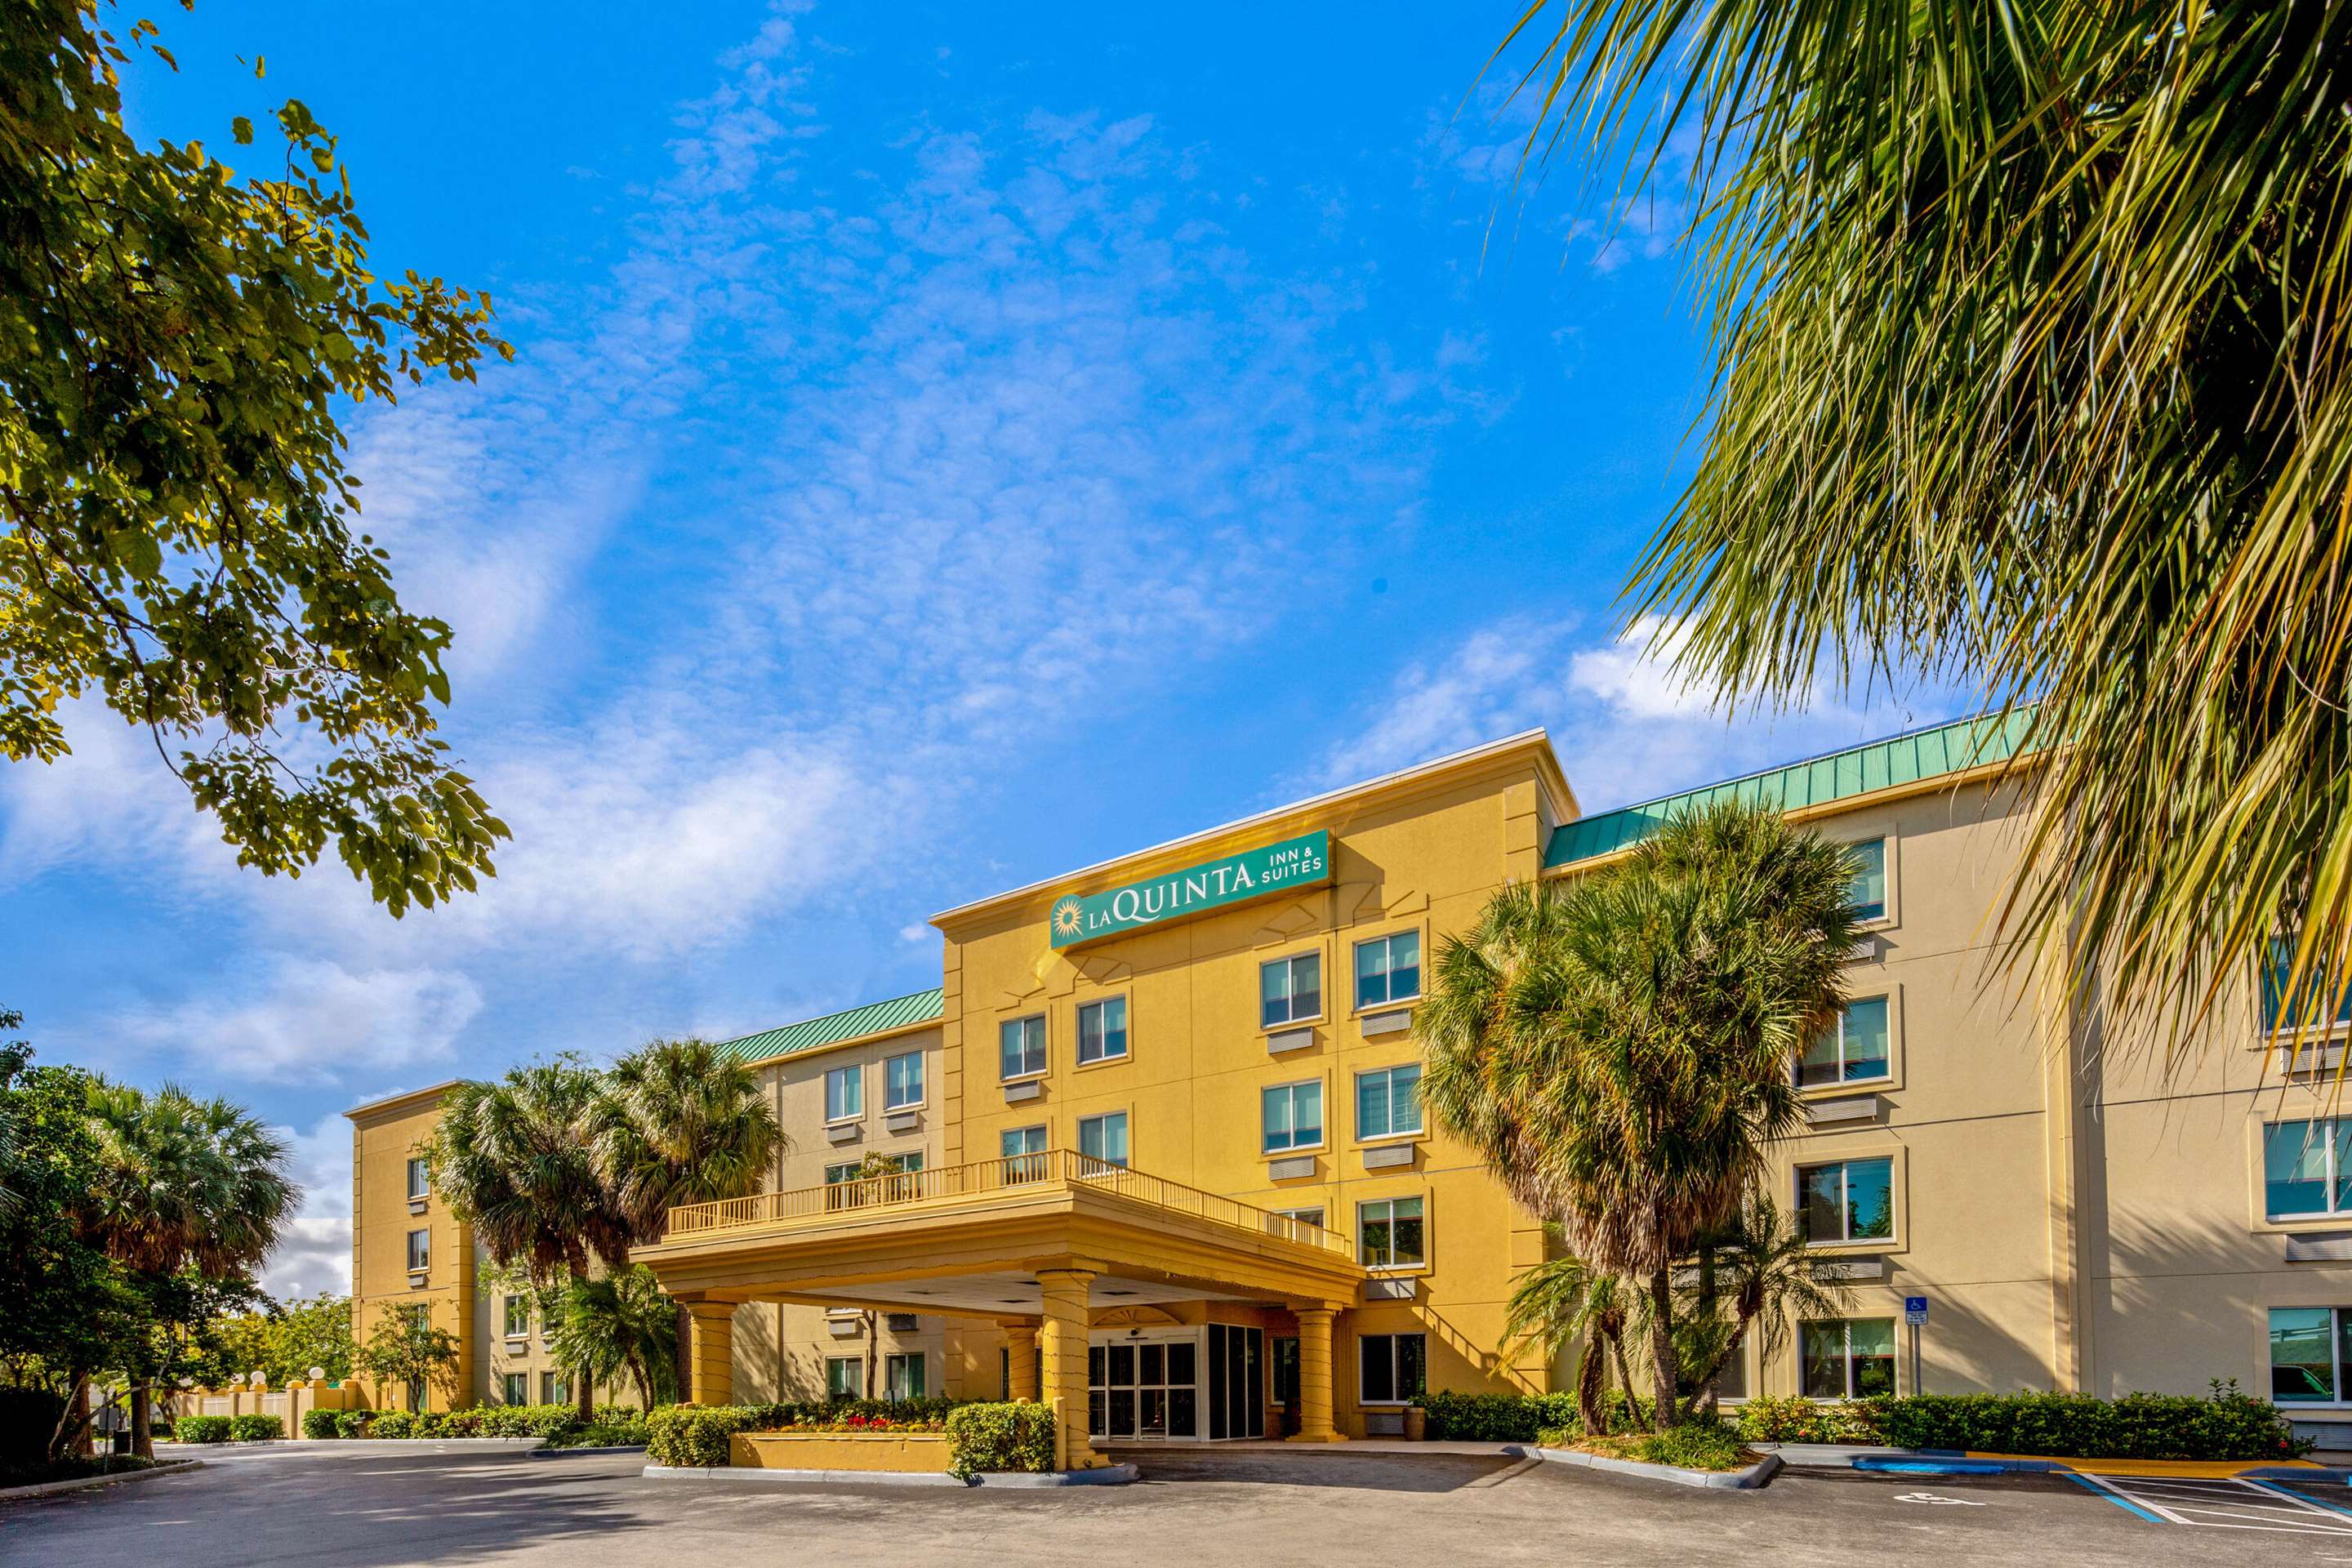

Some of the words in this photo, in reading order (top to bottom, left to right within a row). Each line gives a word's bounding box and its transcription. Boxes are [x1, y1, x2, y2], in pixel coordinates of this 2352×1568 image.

[1270, 848, 1298, 866] INN
[1304, 846, 1312, 858] &
[1262, 858, 1322, 884] SUITES
[1089, 909, 1111, 929] LA
[1112, 862, 1255, 923] QUINTA
